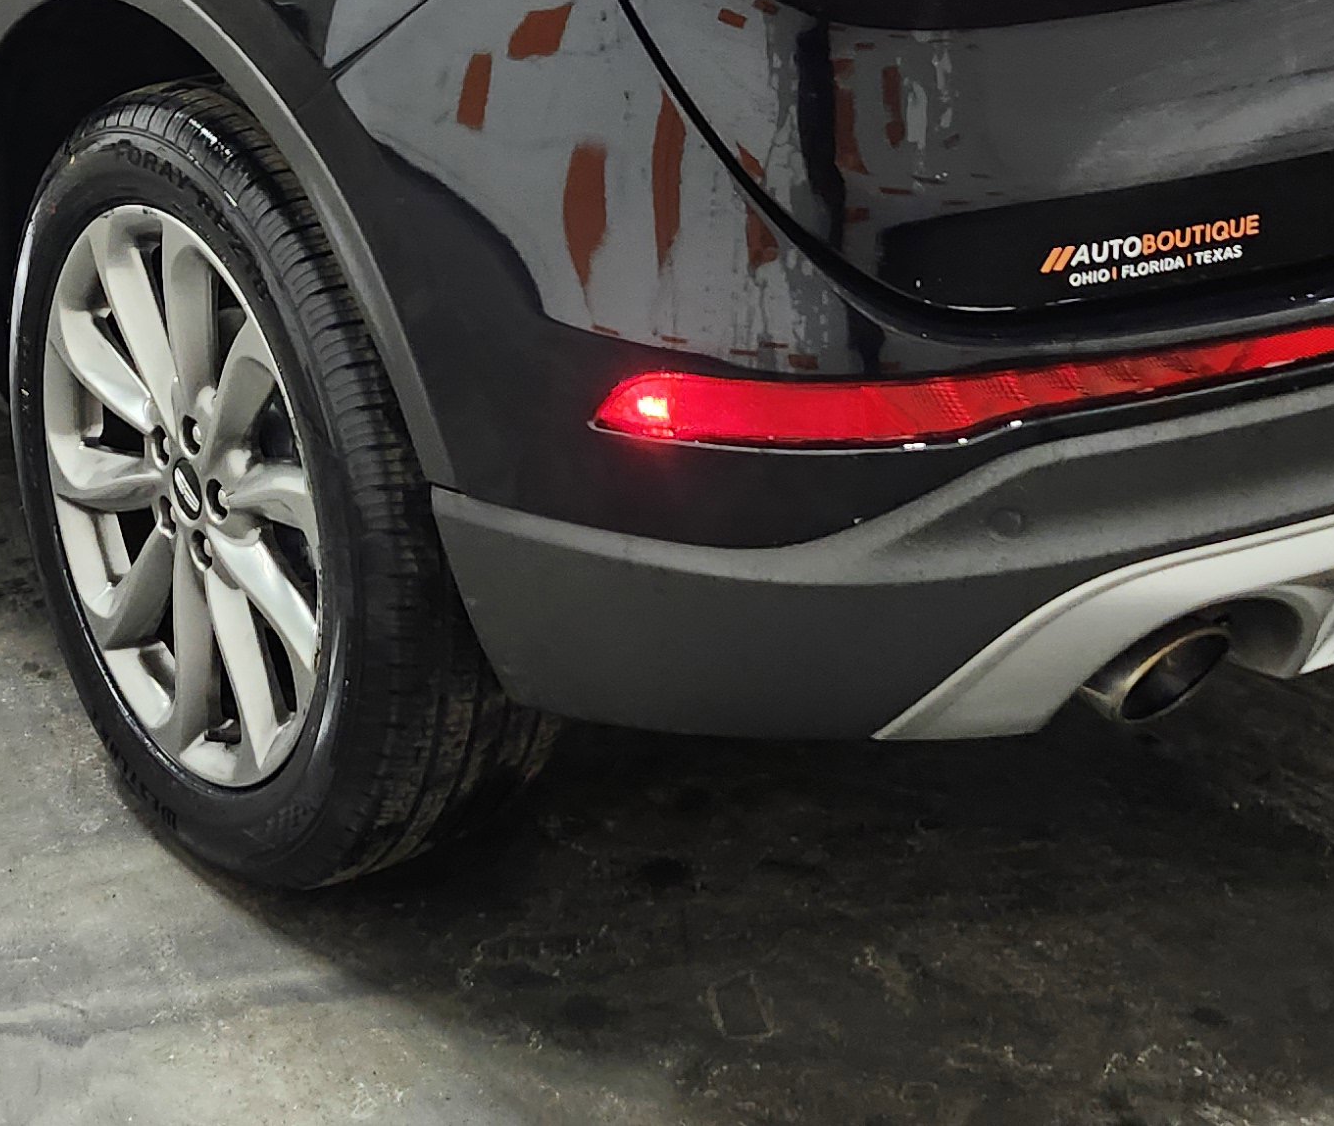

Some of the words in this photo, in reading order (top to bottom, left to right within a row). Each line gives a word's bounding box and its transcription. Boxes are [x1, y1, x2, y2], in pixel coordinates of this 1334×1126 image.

[1070, 214, 1260, 268] AUTOBOUTIQUE
[1068, 268, 1111, 287] OHIO
[1120, 255, 1186, 280] FLORIDA
[1194, 244, 1243, 267] TEXAS
